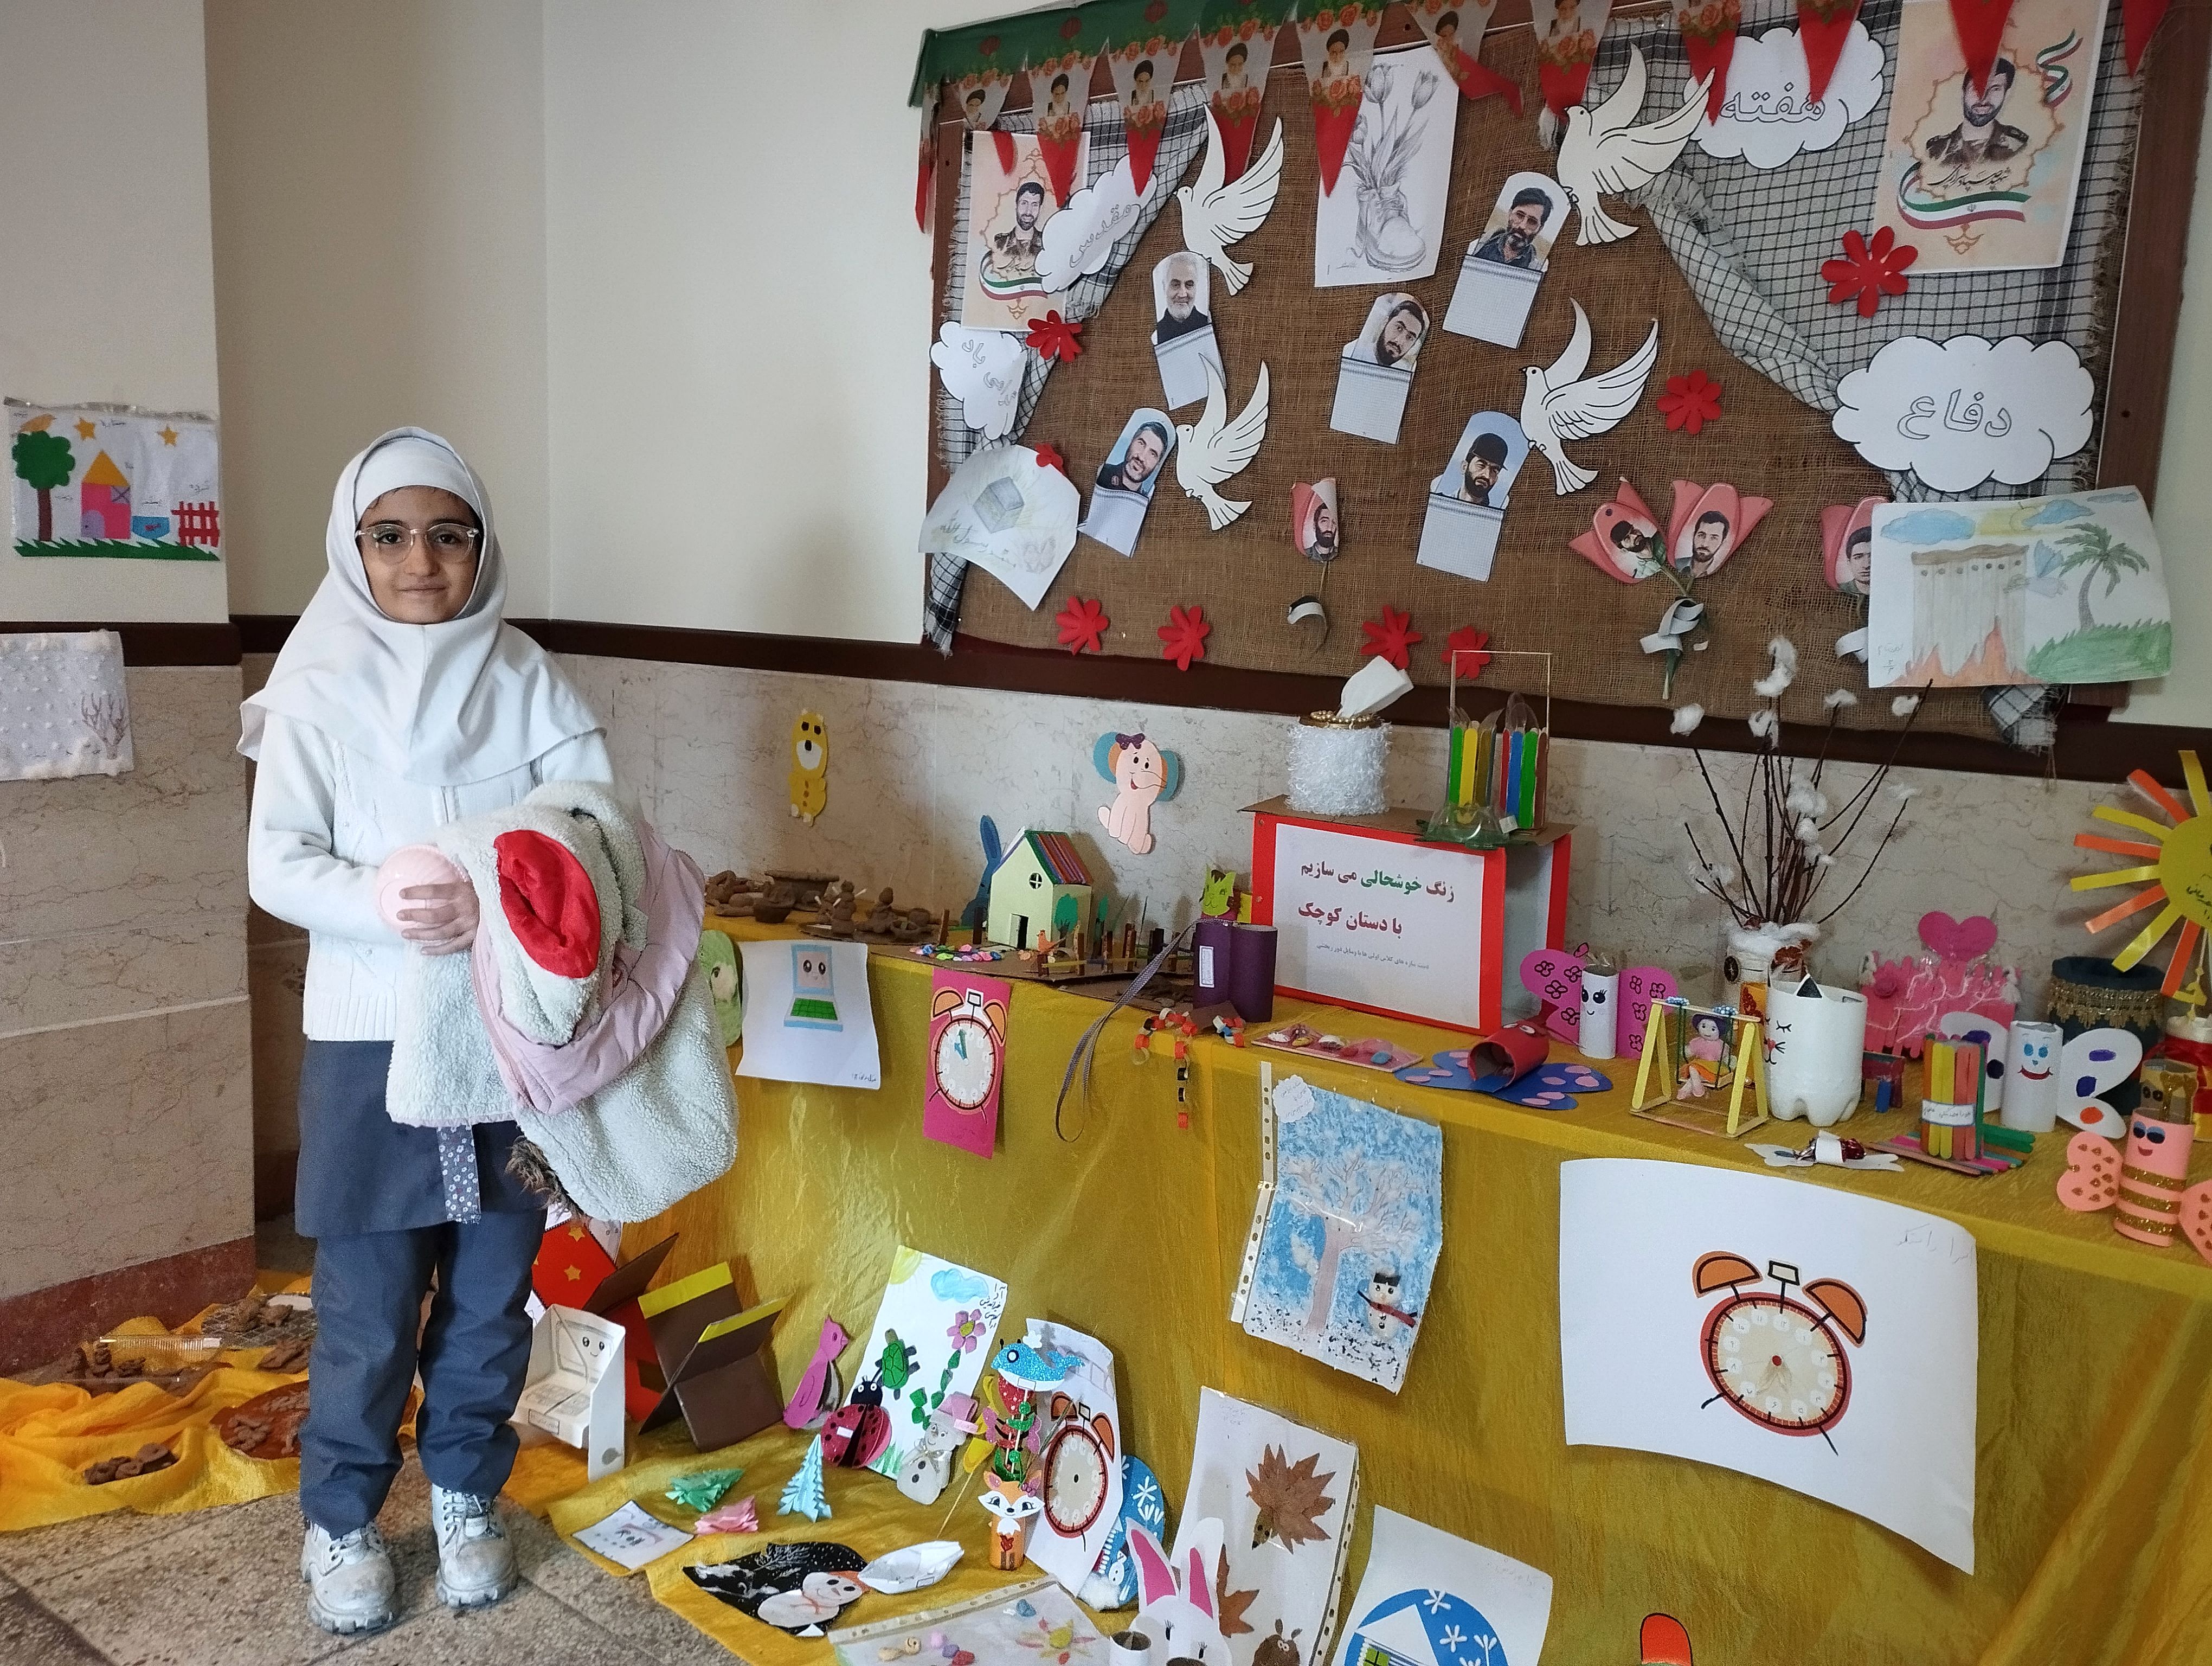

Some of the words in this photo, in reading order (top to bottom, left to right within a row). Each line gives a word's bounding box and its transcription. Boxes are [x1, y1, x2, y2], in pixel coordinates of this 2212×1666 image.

[1720, 82, 1825, 123] هفته
[1069, 204, 1133, 268] مقدس
[1898, 388, 2012, 440] دفاع
[1301, 860, 1334, 879] سازیم
[1337, 870, 1358, 884] می
[1360, 870, 1422, 895] خوشحالی
[1426, 881, 1455, 902] زنگ
[1298, 902, 1342, 926] کوچک
[1345, 911, 1388, 932] دستان
[1392, 917, 1403, 939] با
